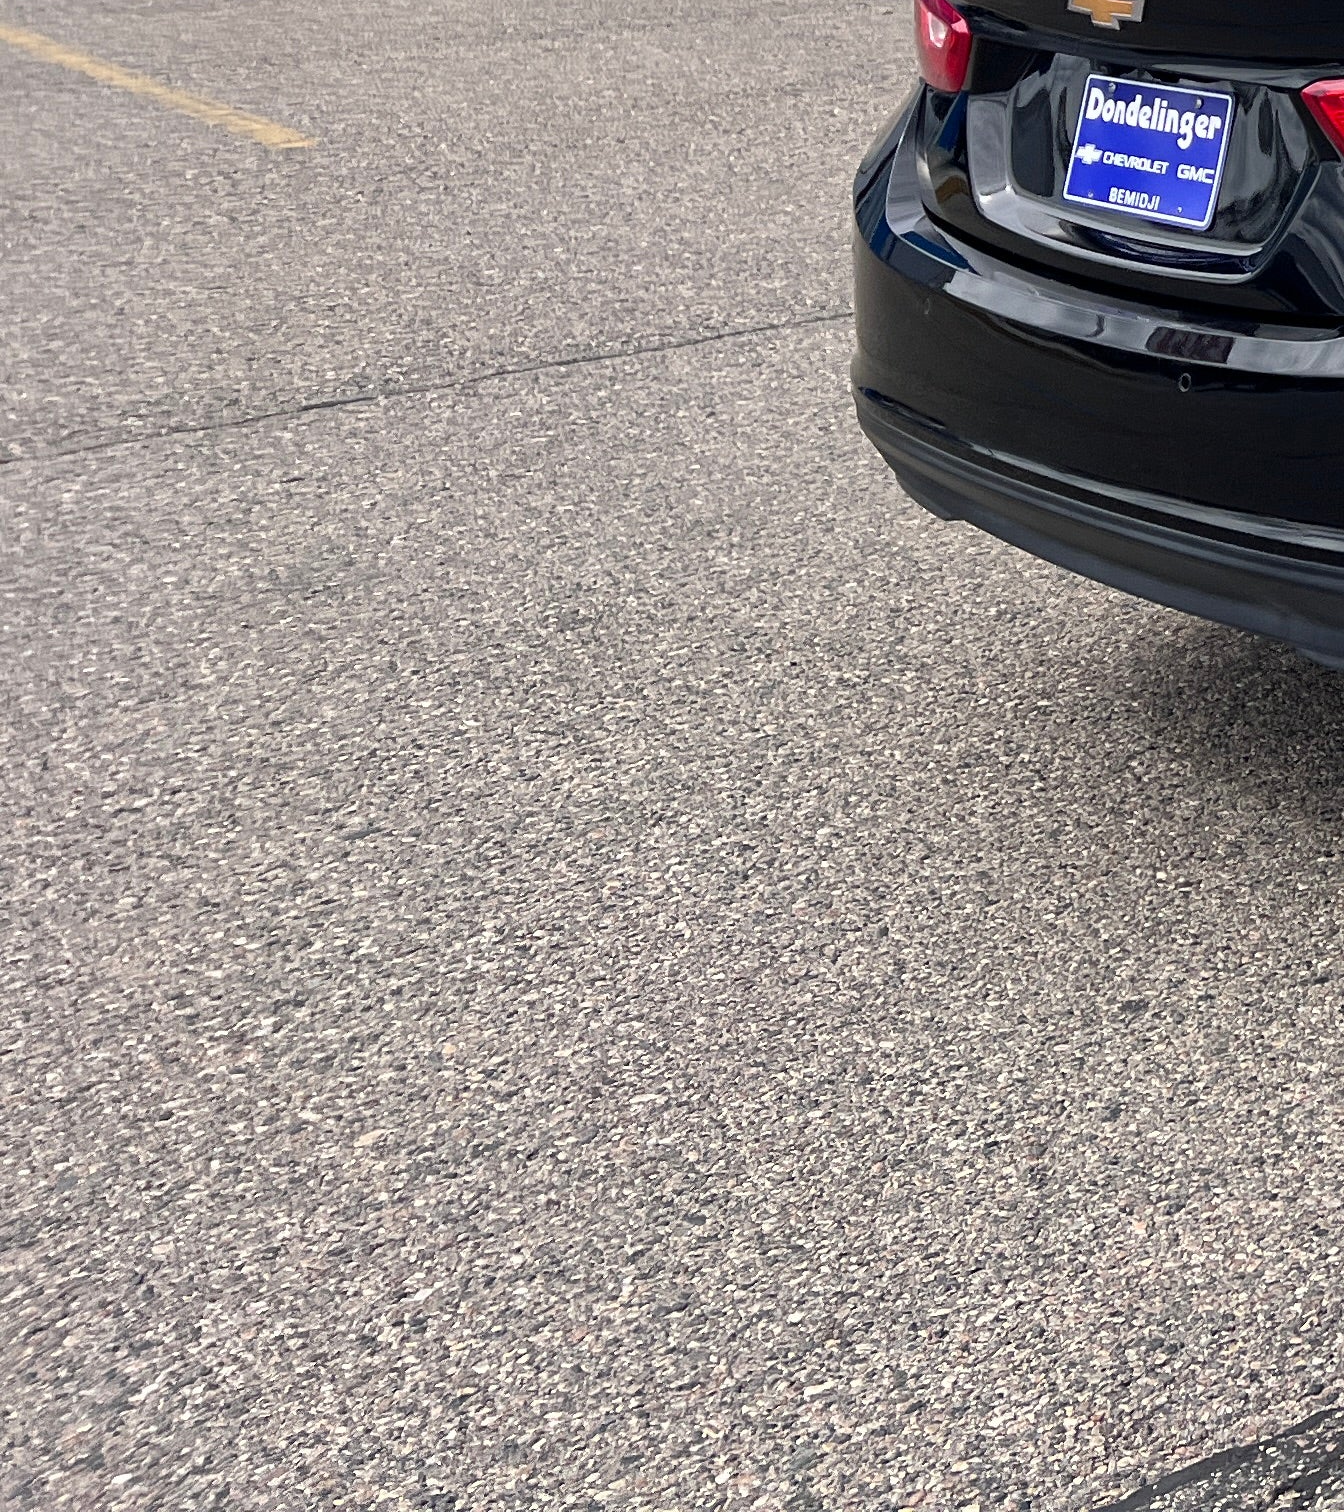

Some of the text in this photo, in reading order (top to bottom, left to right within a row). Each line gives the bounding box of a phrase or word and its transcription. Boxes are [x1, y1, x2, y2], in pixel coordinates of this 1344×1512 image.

[1085, 87, 1222, 150] Dondelinger
[1102, 151, 1215, 185] CHEVROLET GMC
[1108, 186, 1160, 211] BEMIDJI
